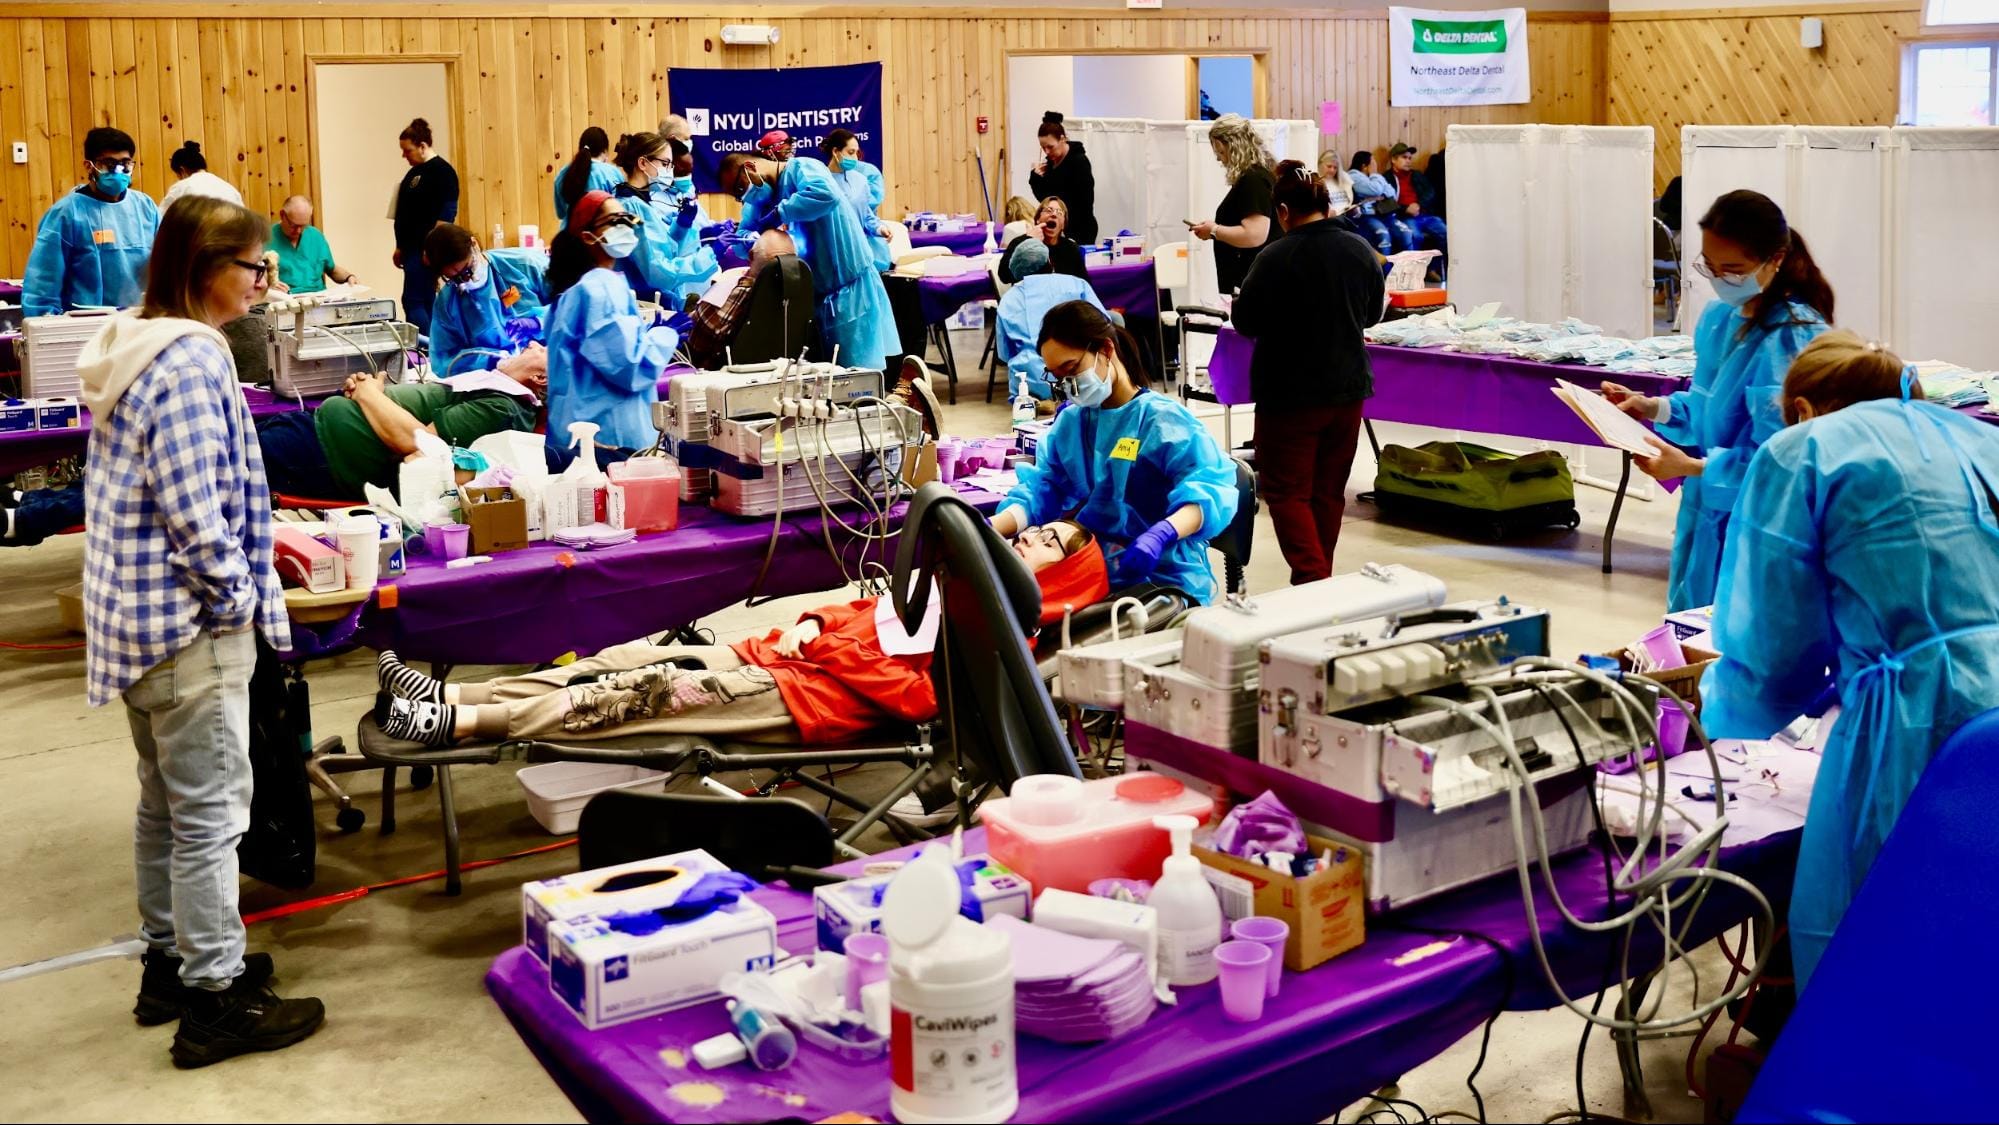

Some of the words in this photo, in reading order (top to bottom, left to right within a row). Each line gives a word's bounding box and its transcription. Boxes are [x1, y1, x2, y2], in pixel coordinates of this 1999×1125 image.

[1434, 32, 1462, 43] DELTA
[1462, 31, 1497, 43] DENTAL
[1410, 65, 1456, 76] Northeast
[1458, 66, 1480, 76] Delta
[1482, 64, 1505, 75] Dental
[714, 113, 754, 130] NYU
[764, 105, 863, 129] DENTISTRY
[712, 139, 753, 152] Global
[391, 559, 400, 569] M
[632, 948, 677, 965] FitGuard
[751, 955, 770, 972] M
[915, 1013, 999, 1032] CaviWipes
